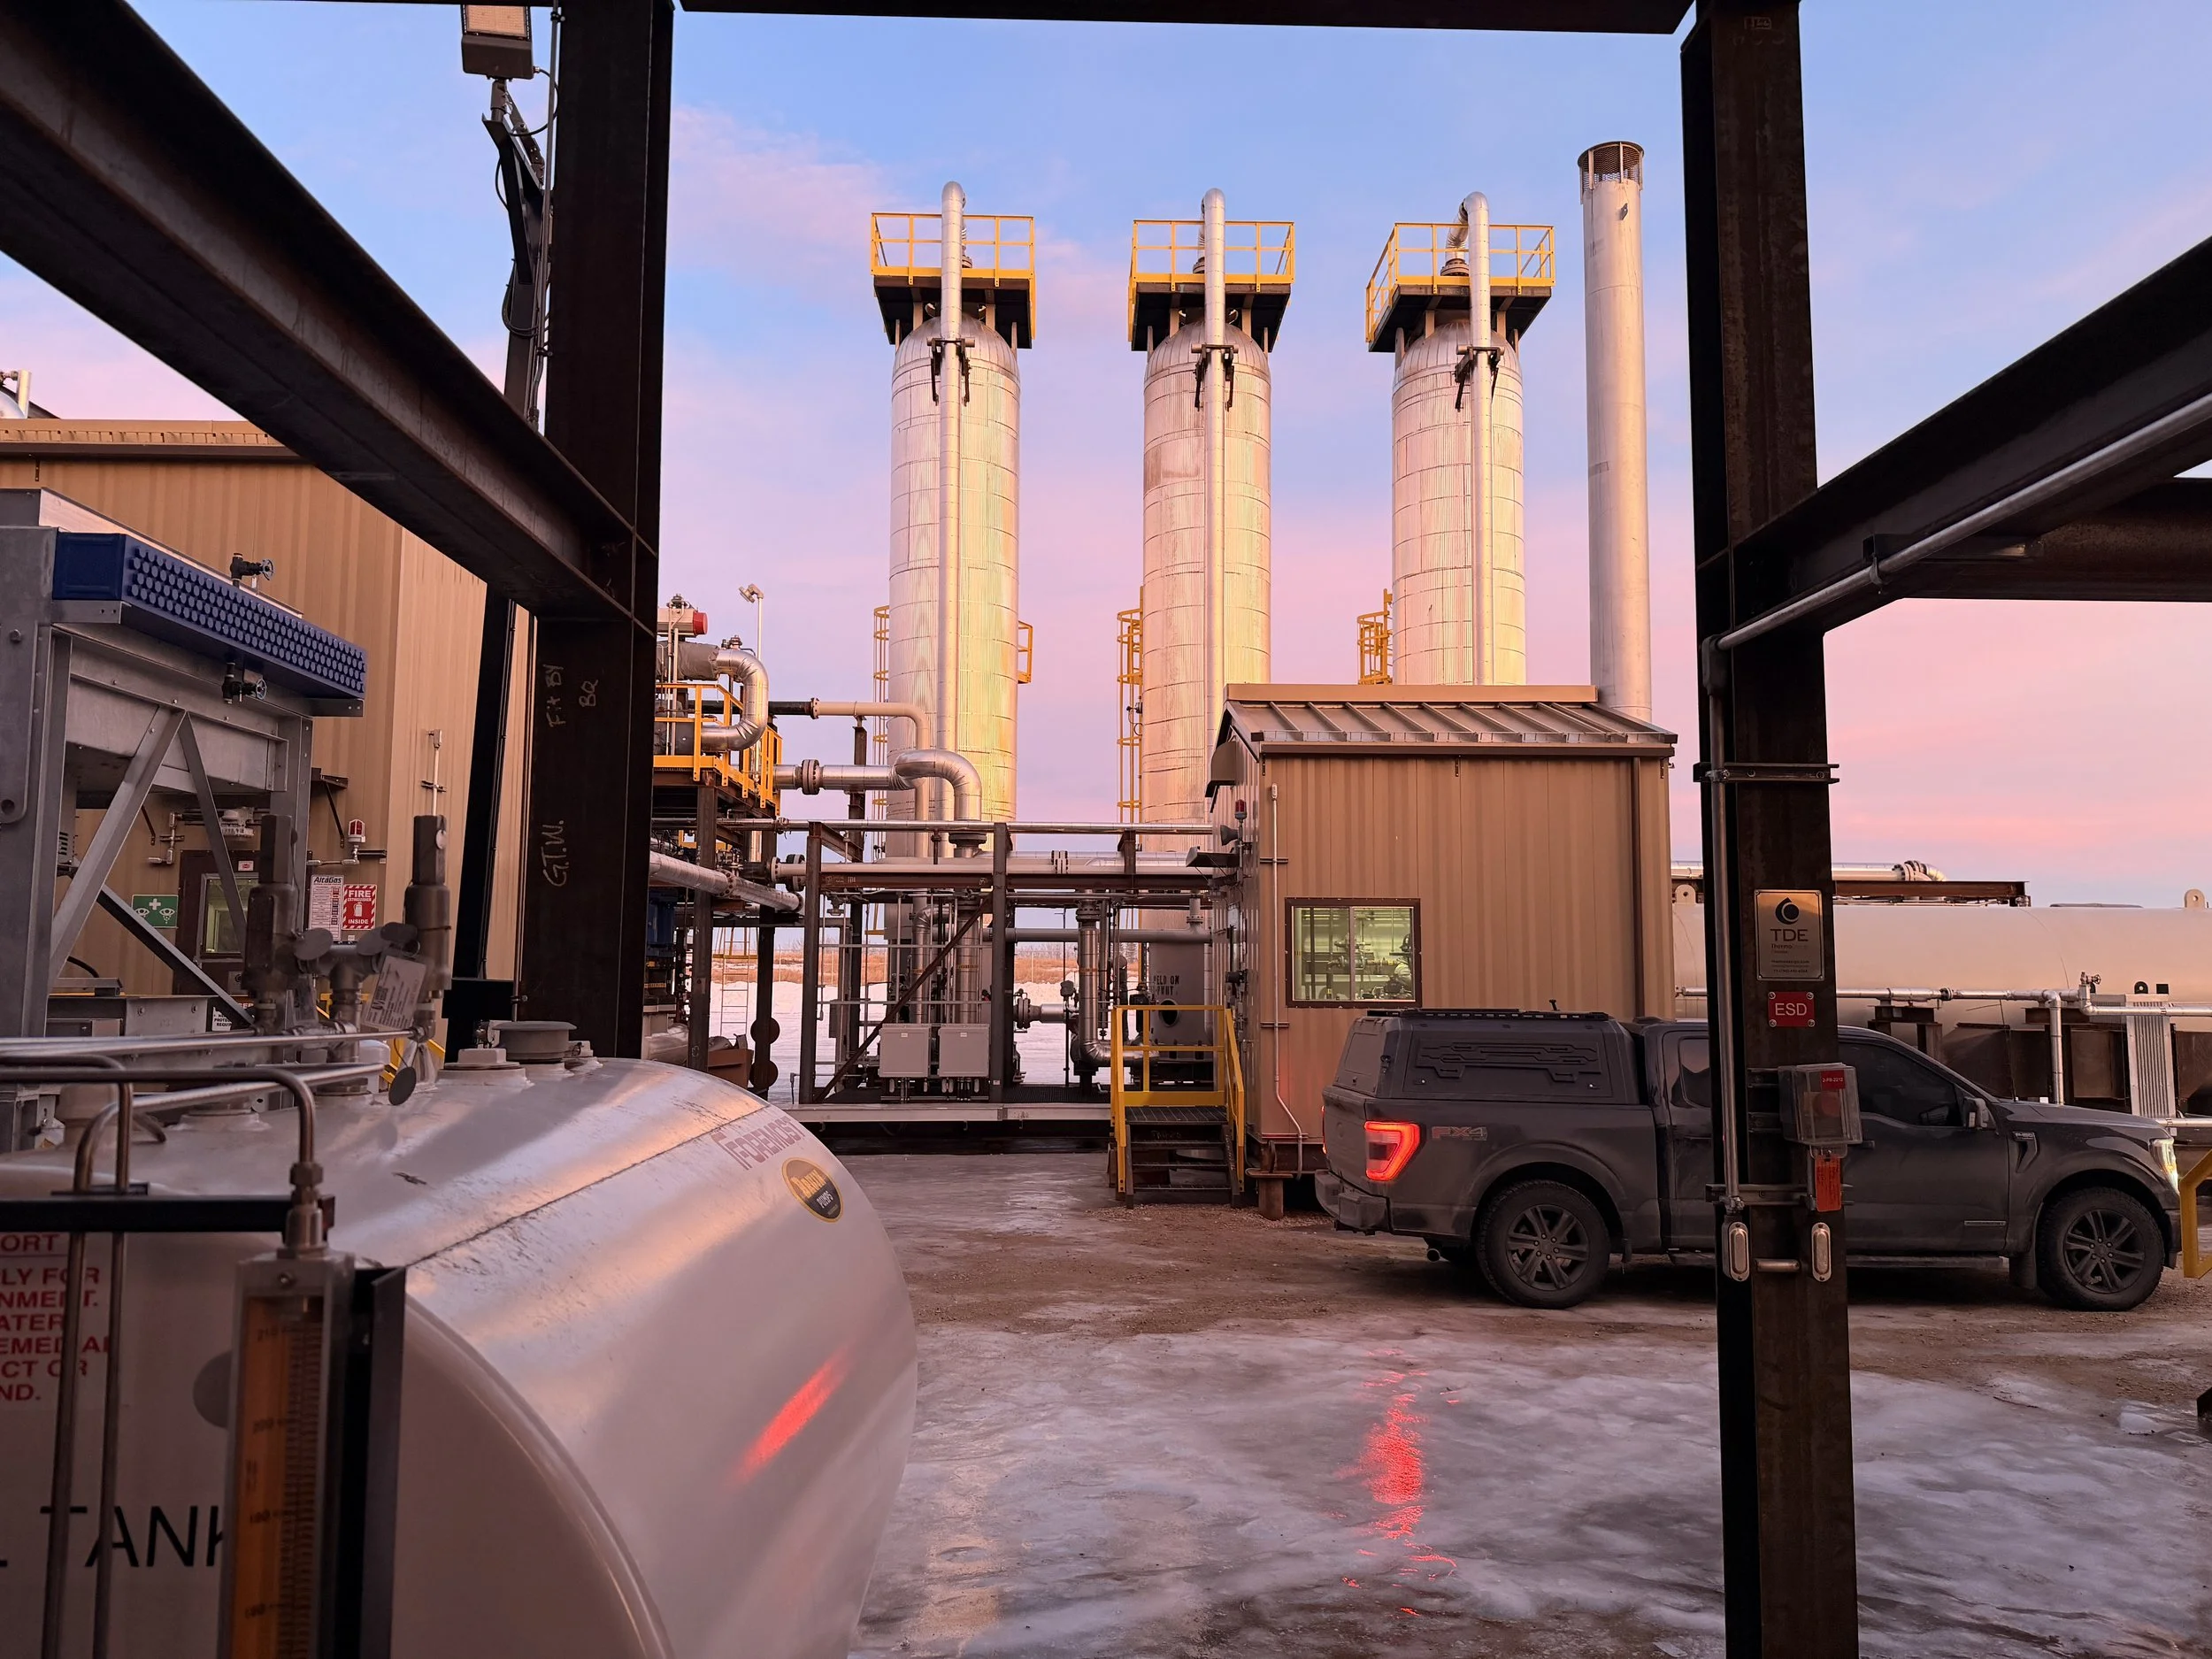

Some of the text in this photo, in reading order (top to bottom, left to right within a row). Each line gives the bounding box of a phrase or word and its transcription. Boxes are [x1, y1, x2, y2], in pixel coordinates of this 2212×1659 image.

[1770, 928, 1809, 941] TDE
[1775, 1003, 1807, 1016] ESD
[1432, 1126, 1487, 1141] FX4
[710, 1115, 805, 1171] FOREMOST
[0, 1290, 98, 1309] NMET.
[82, 1336, 110, 1353] A
[41, 1506, 223, 1567] AN
